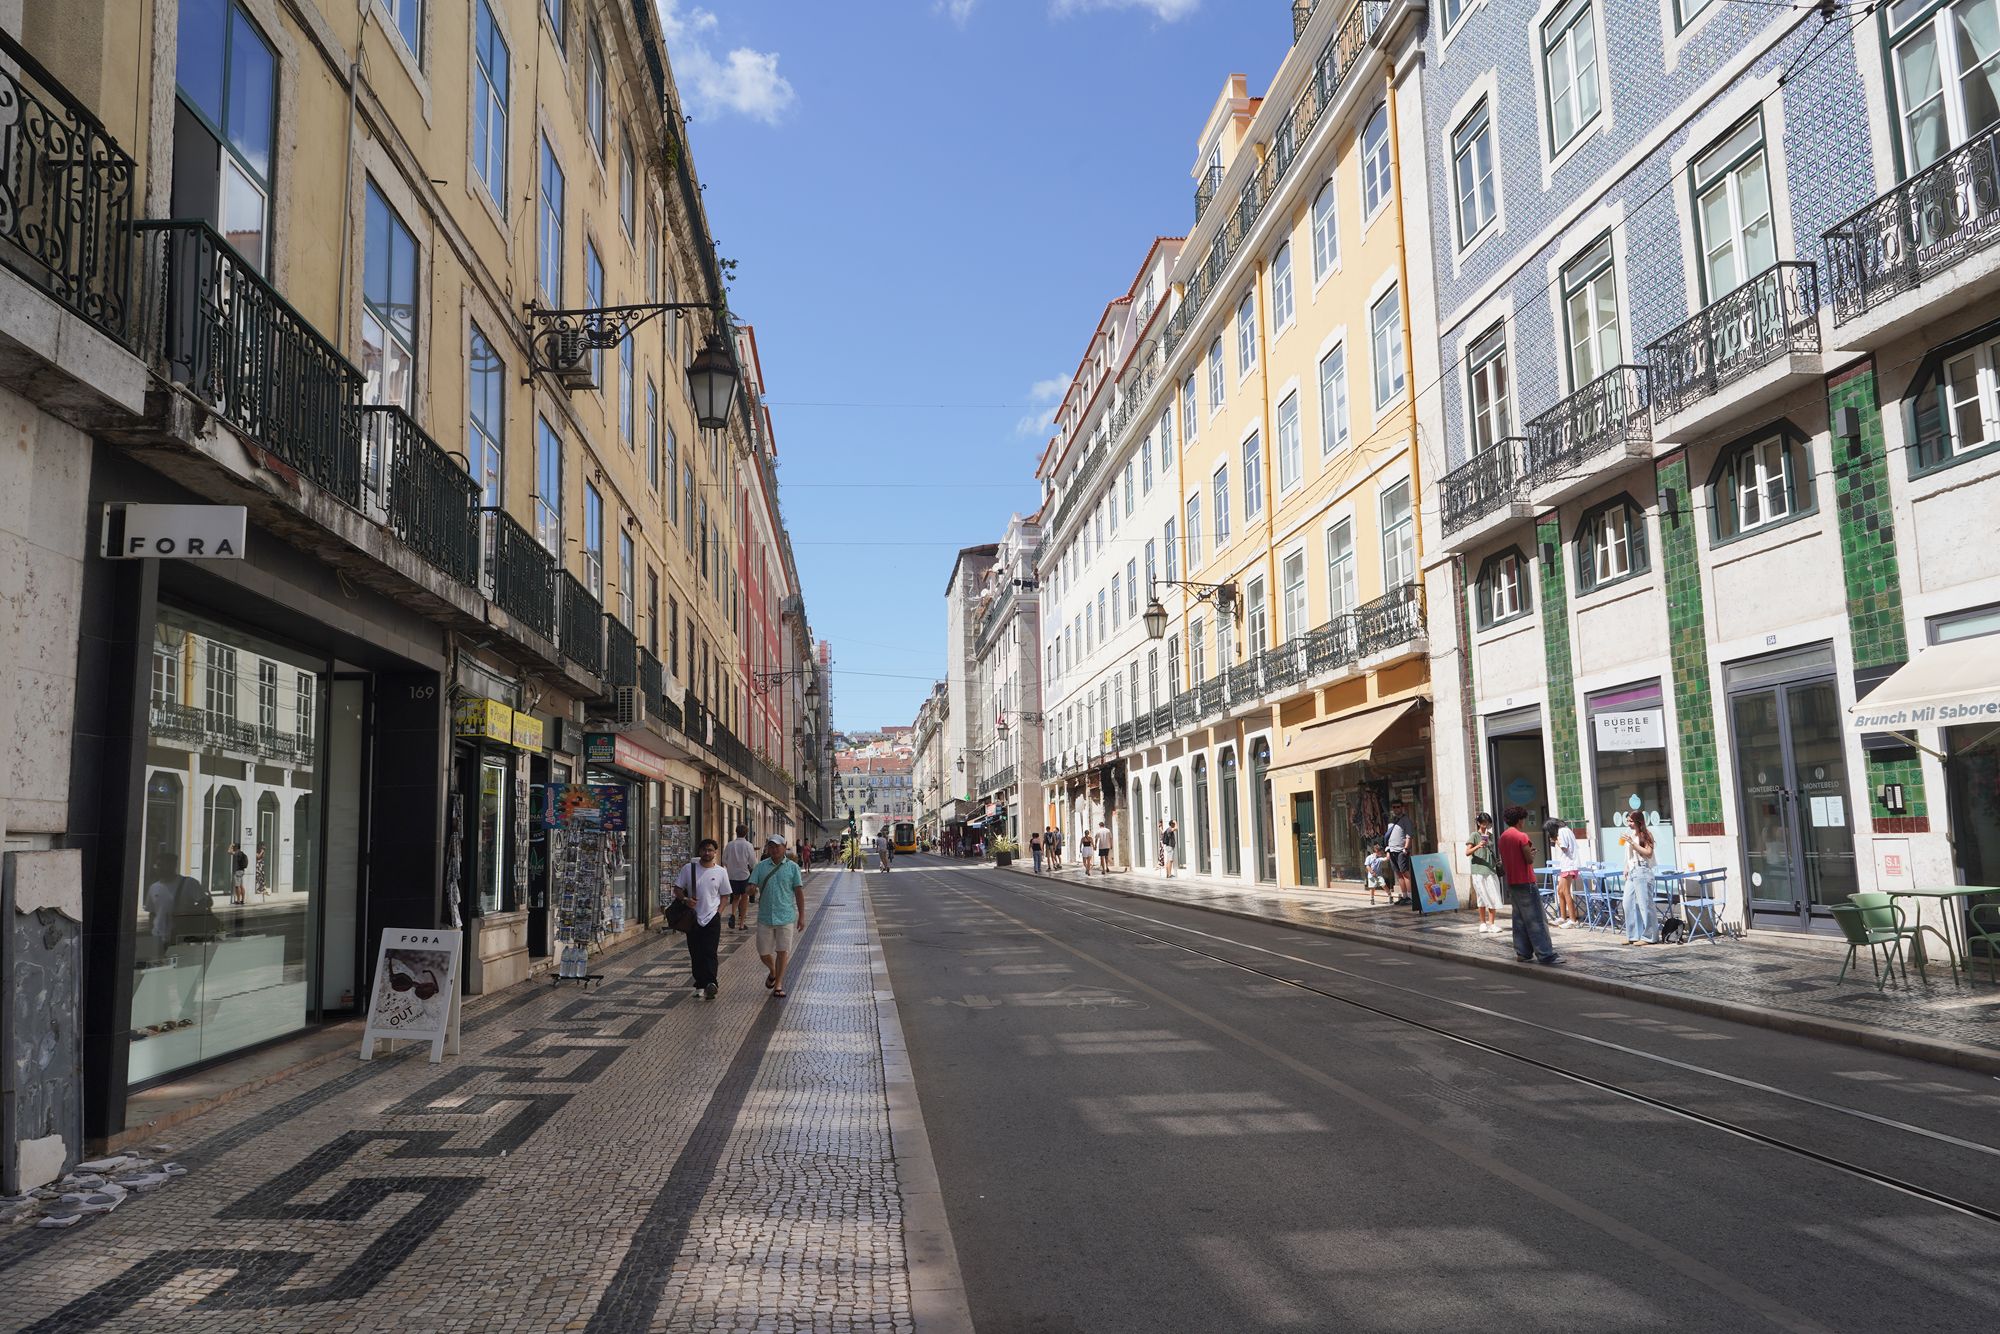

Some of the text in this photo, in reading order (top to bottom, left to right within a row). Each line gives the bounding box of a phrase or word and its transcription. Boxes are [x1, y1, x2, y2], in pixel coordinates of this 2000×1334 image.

[129, 537, 234, 555] FORA
[409, 686, 434, 699] 169
[1854, 702, 2000, 727] Brunch Mil Sabore
[1747, 785, 1780, 793] MONTEBELO
[1803, 780, 1840, 789] MONTEBELO
[401, 935, 439, 944] FORA
[390, 1005, 413, 1026] OUT
